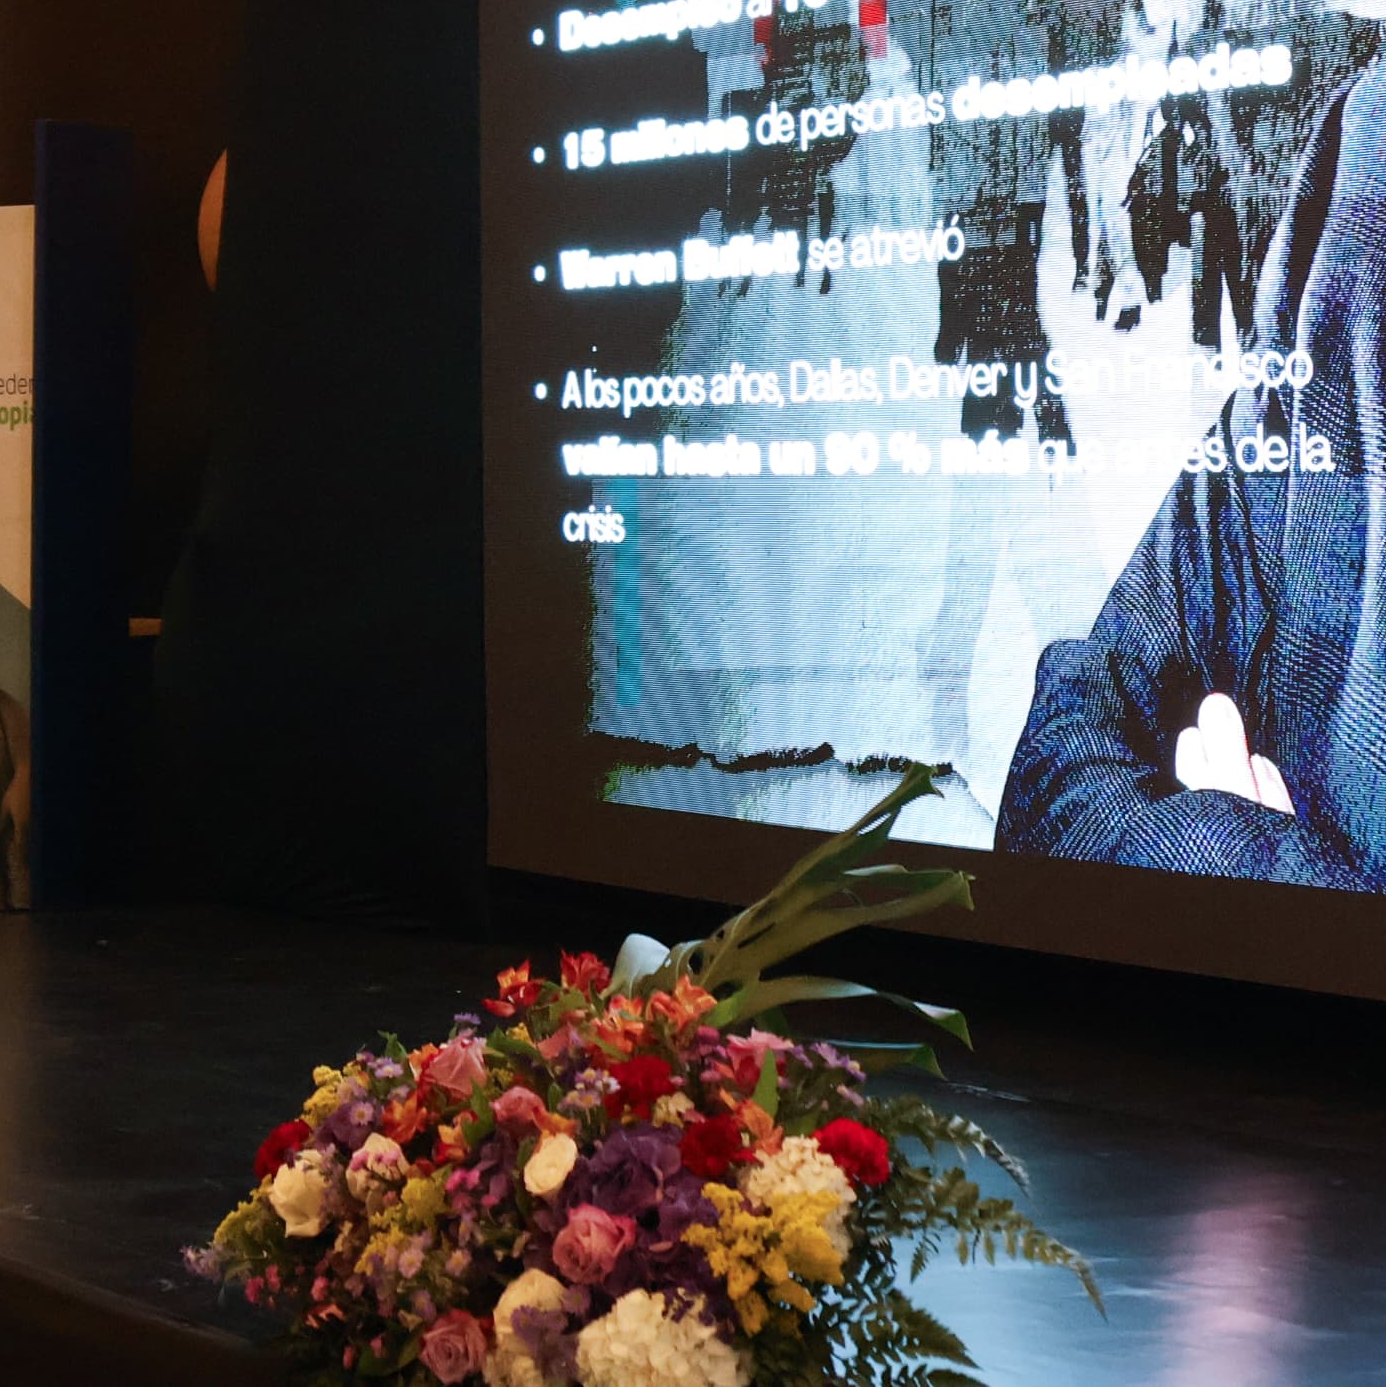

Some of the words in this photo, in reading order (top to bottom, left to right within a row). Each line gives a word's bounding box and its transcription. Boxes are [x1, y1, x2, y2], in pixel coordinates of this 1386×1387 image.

[563, 128, 606, 171] 15
[611, 114, 749, 164] millones
[756, 101, 795, 146] de
[800, 90, 946, 152] personas
[952, 43, 1294, 122] desempleadas
[559, 248, 677, 291] Warren
[807, 237, 845, 271] se
[850, 215, 965, 266] atrevió
[561, 370, 582, 409] A
[584, 368, 620, 408] los
[623, 374, 705, 418] pocos
[709, 362, 785, 408] años,
[889, 356, 1007, 399] Denver
[1014, 362, 1037, 409] y
[1047, 349, 1115, 395] San
[769, 440, 816, 475] un
[888, 430, 932, 475] %
[1038, 440, 1105, 486] que
[1115, 427, 1227, 474] antes
[1235, 422, 1289, 473] de
[1298, 422, 1336, 473] la
[562, 505, 626, 543] crisis
